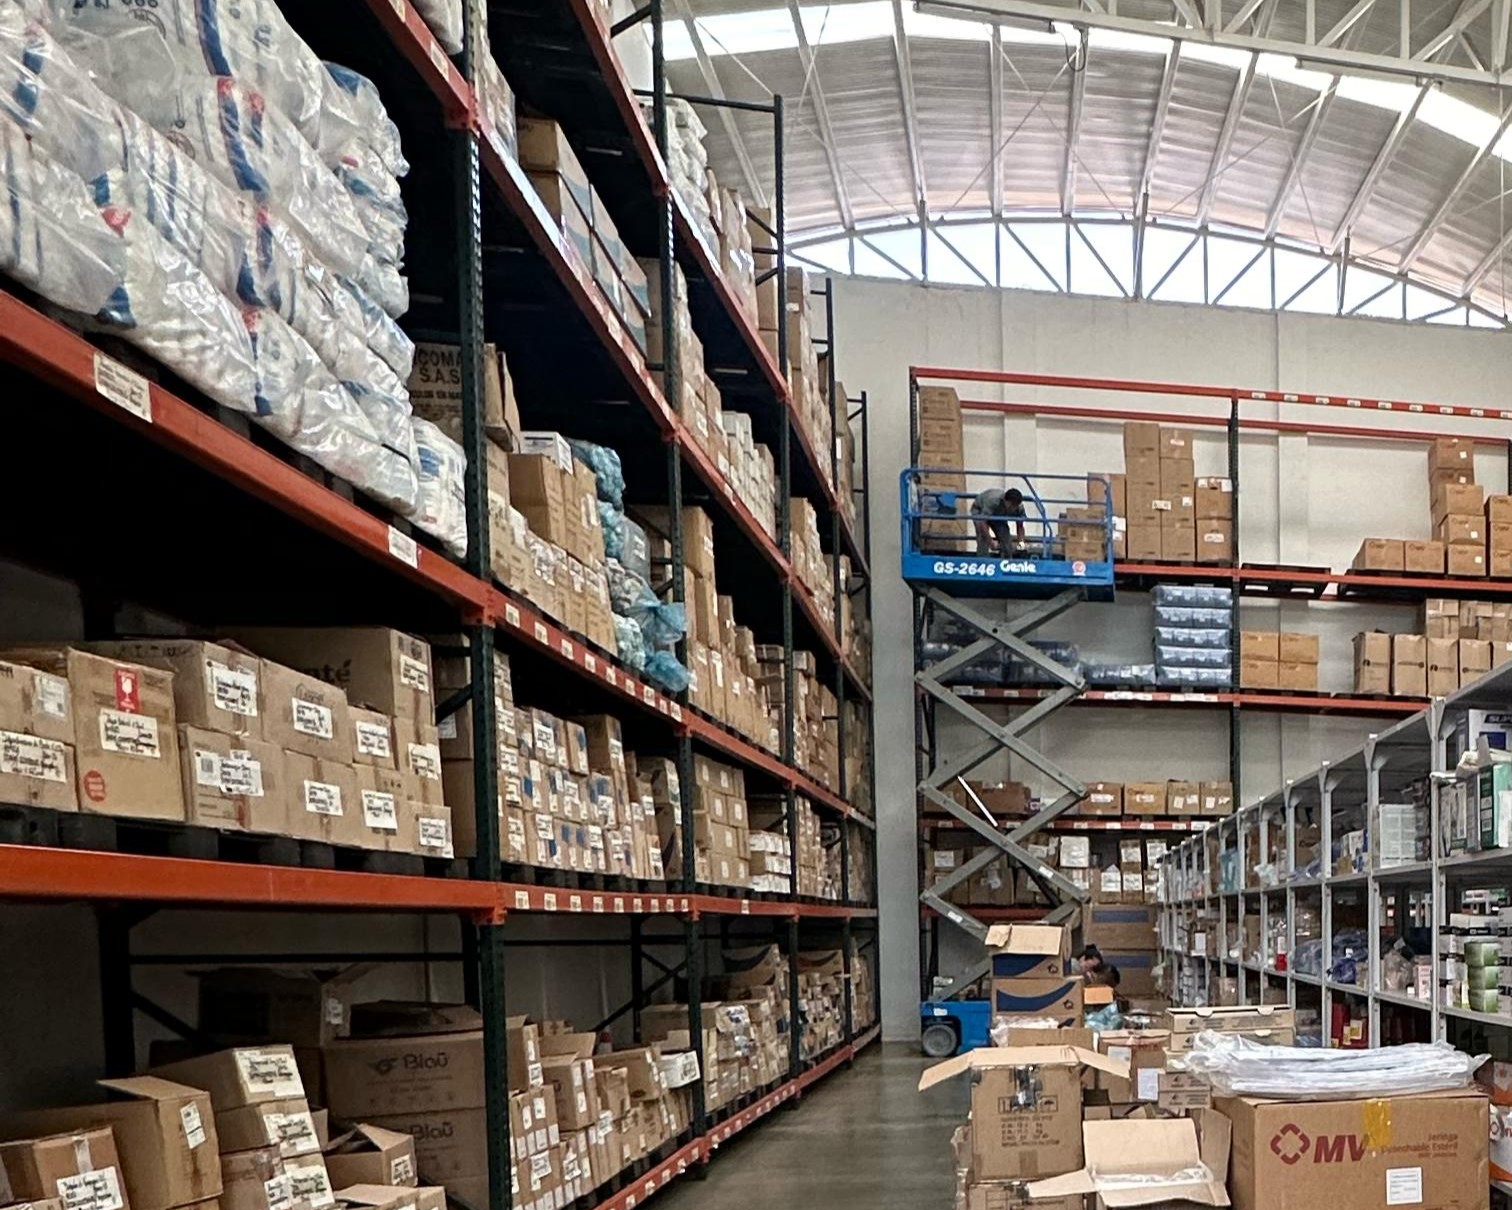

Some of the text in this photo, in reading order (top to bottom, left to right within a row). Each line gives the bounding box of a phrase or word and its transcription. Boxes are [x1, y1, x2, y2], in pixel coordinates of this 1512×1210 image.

[933, 559, 1037, 577] GS-2646 Genie
[1313, 1134, 1369, 1163] MV
